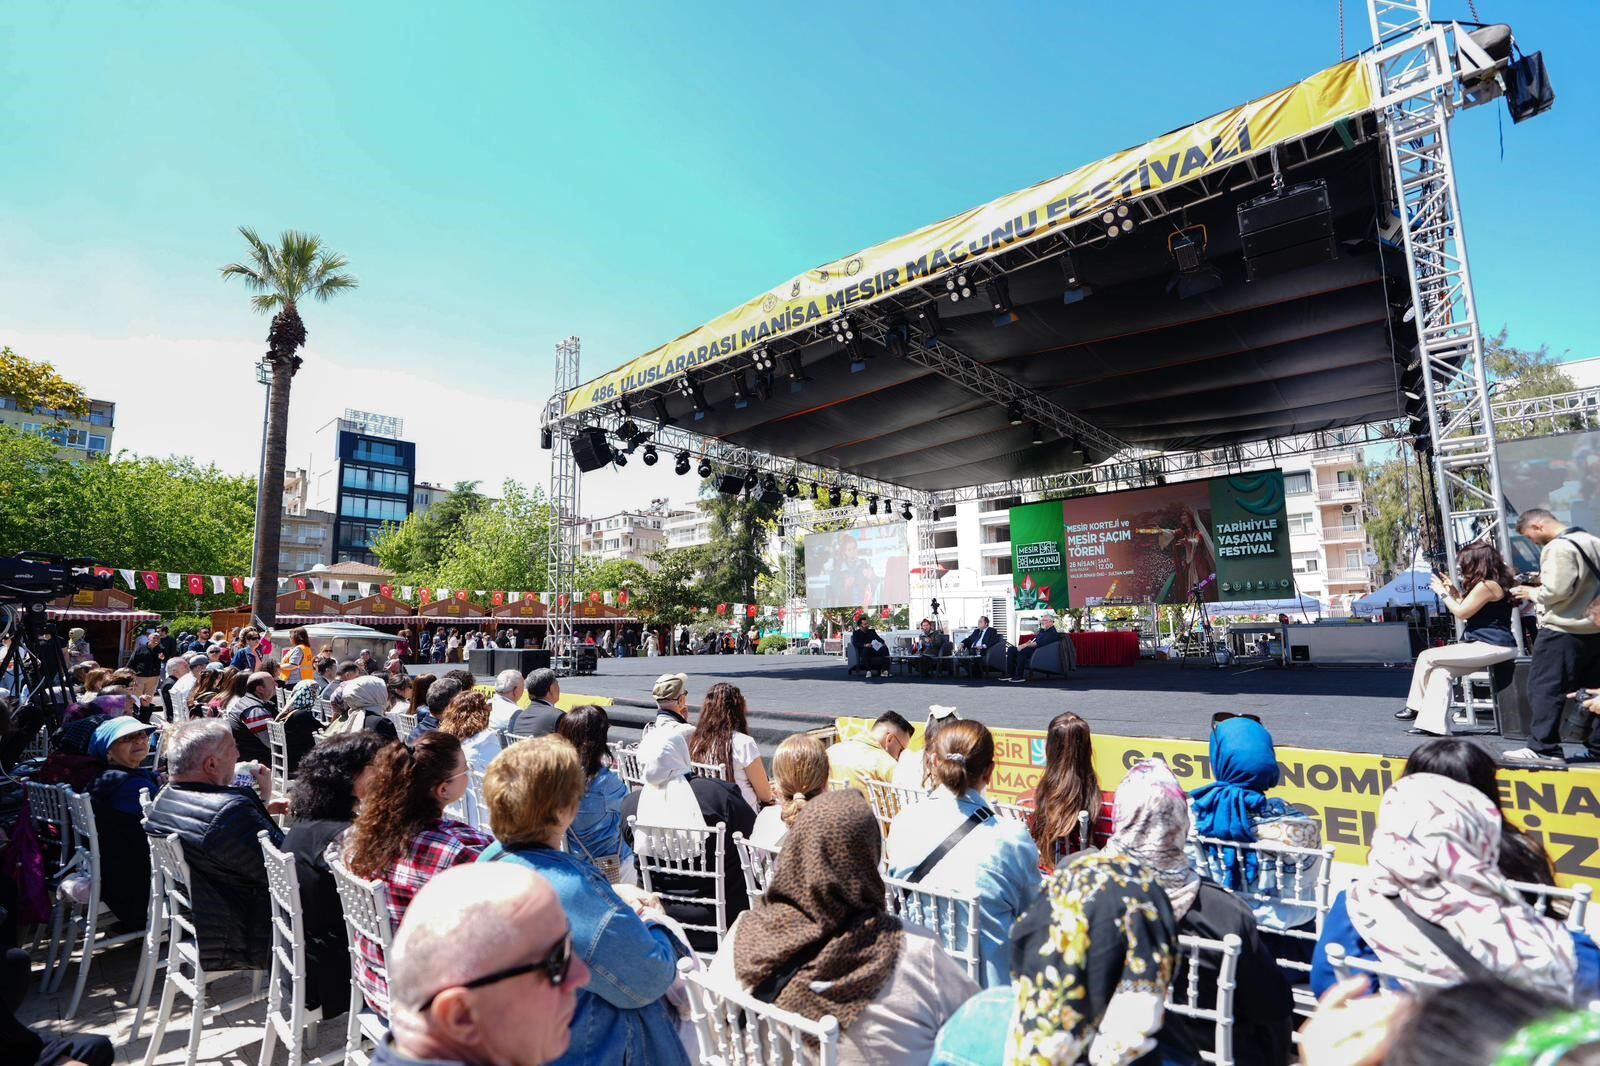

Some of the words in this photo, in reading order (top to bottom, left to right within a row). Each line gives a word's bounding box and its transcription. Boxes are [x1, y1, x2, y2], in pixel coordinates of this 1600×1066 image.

[592, 382, 617, 402] 486.
[620, 335, 737, 393] ULUSLARARASI
[741, 301, 822, 348] MANİSA
[825, 267, 900, 314] MESİR
[905, 210, 1037, 281] MACUNU
[1047, 118, 1252, 227] FESTİVALİ
[1067, 523, 1088, 532] MESİR
[1089, 518, 1119, 530] KORTEJİ
[1216, 519, 1278, 533] TARİHİYLE
[1068, 532, 1097, 546] MESİR
[1099, 530, 1131, 543] SAÇIM
[1217, 532, 1273, 545] YAŞAYAN
[1018, 545, 1039, 554] MESİR
[1068, 543, 1105, 557] TÖRENİ
[1218, 543, 1275, 557] FESTİVAL
[1028, 555, 1058, 565] MACUNU
[994, 738, 1023, 760] SİR
[996, 770, 1039, 790] MAC
